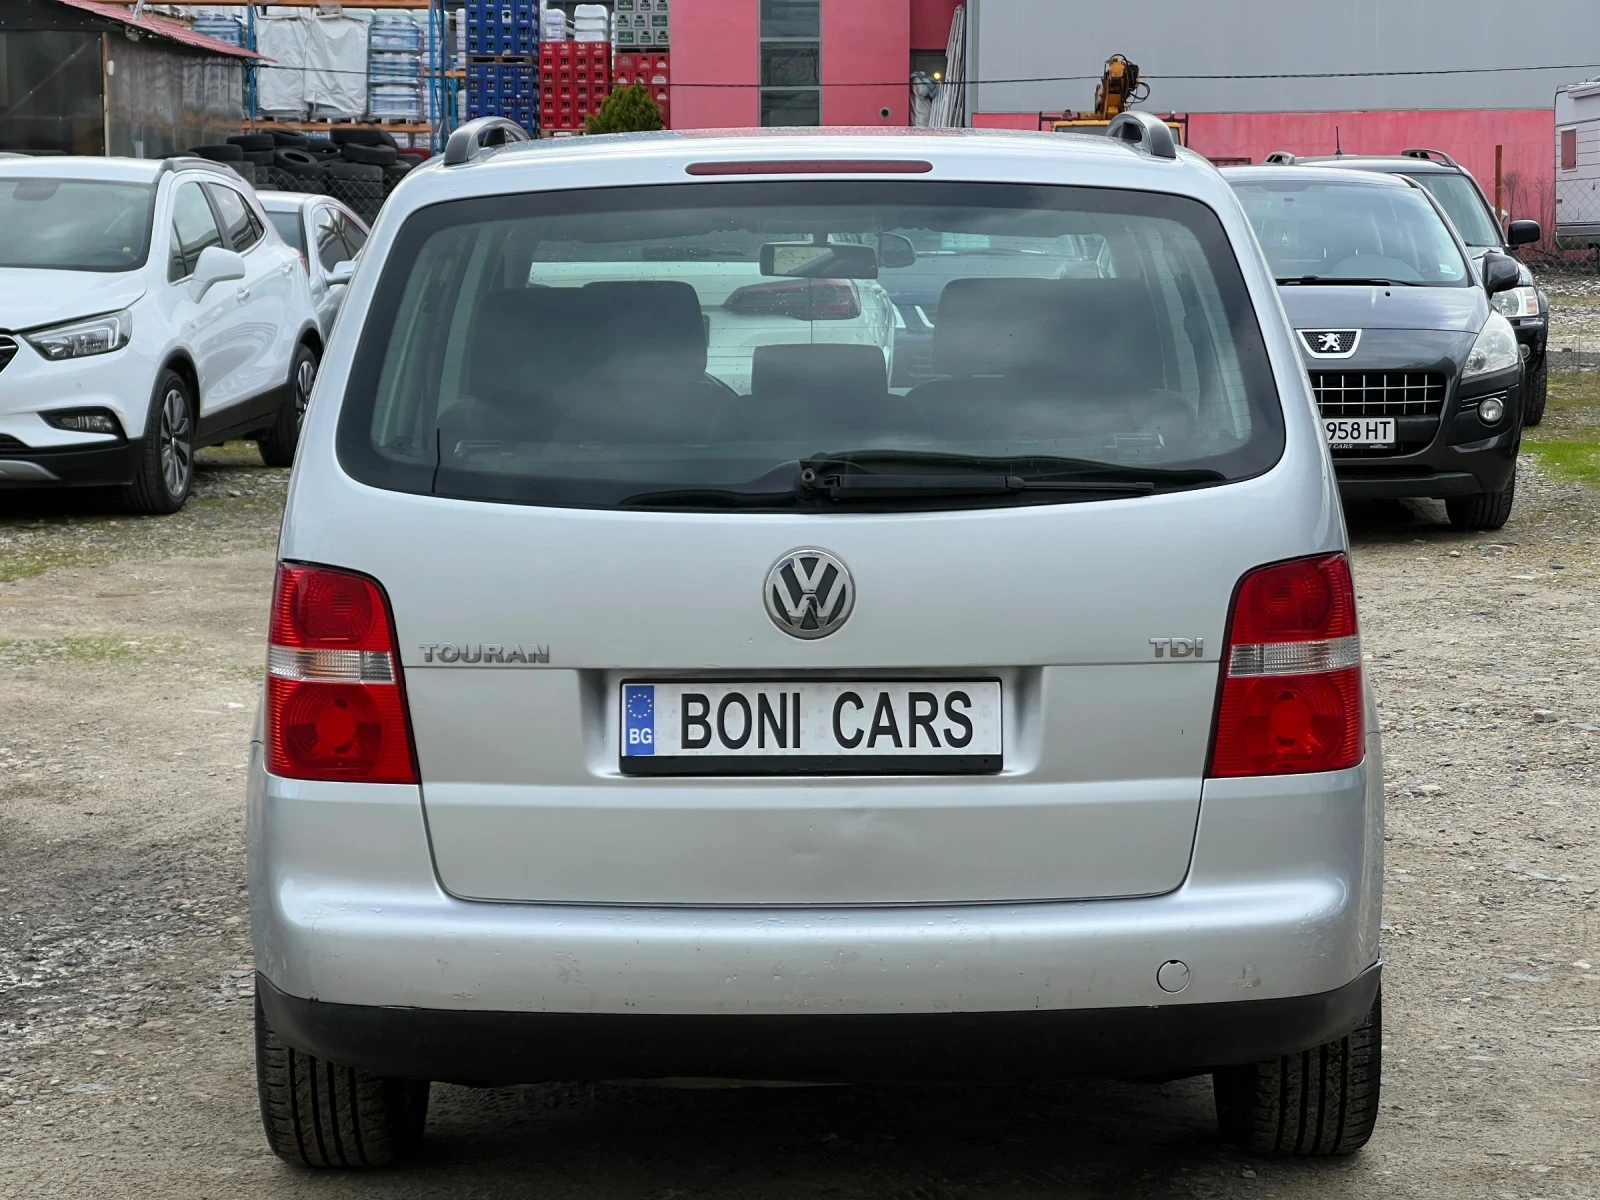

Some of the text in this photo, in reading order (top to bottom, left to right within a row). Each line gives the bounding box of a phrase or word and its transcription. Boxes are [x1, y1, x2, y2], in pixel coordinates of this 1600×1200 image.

[1366, 421, 1391, 440] HT
[419, 642, 550, 664] TOURAN
[1149, 637, 1203, 658] TDI
[681, 691, 974, 750] BONI CARS
[629, 728, 653, 744] BG
